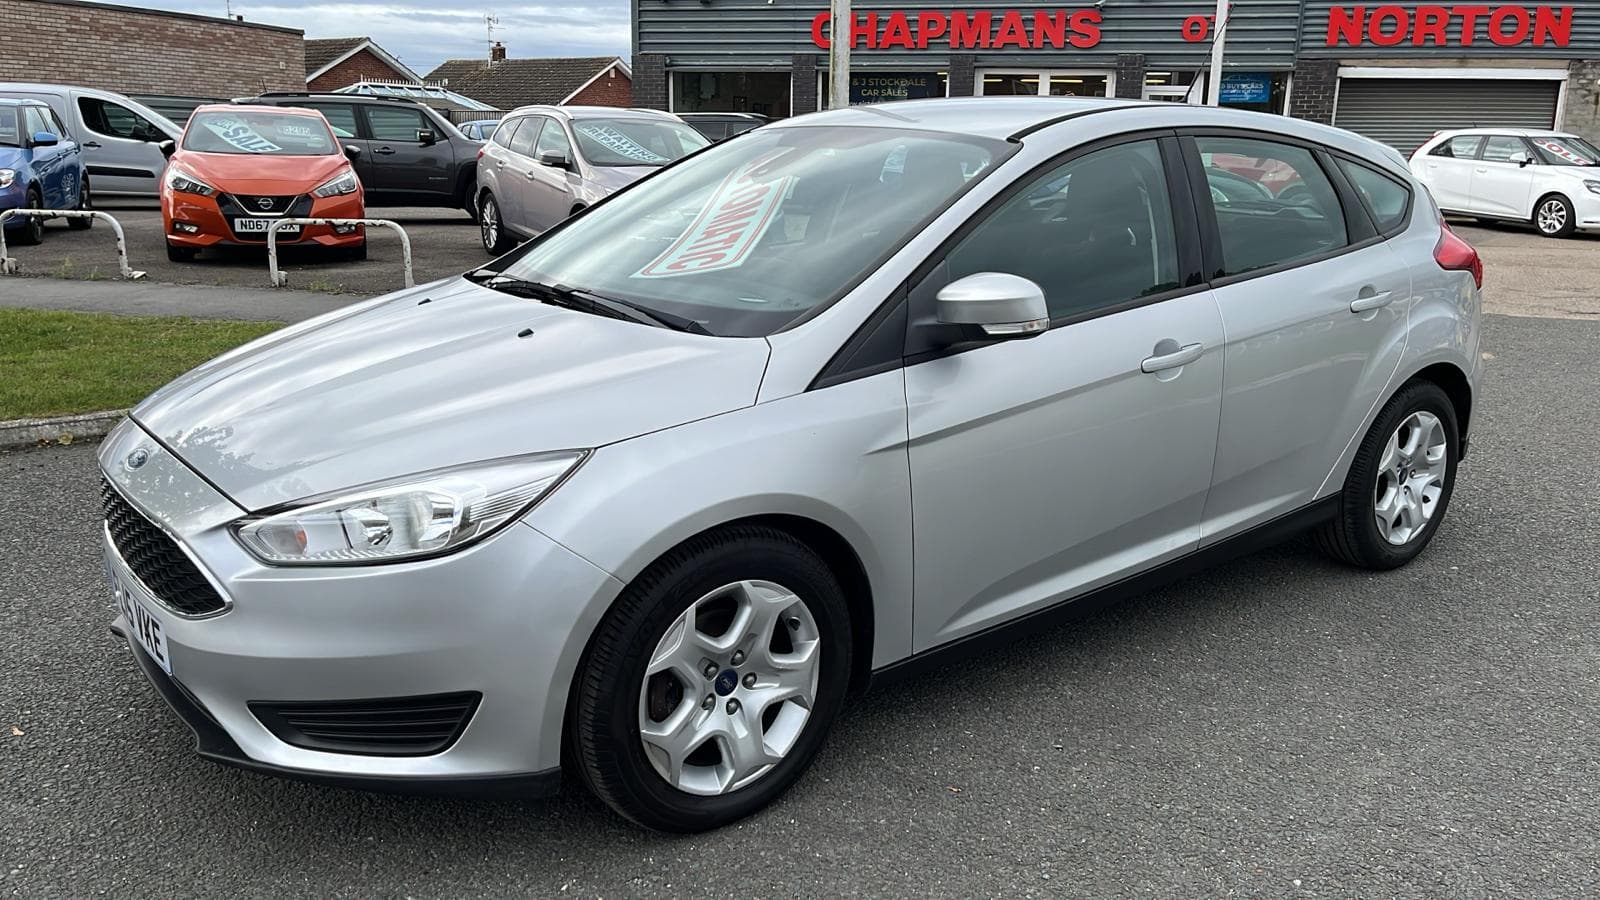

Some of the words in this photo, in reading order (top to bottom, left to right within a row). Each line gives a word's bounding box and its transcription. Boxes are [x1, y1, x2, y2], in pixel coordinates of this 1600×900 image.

[811, 9, 1103, 49] CHAPMANS
[1326, 5, 1575, 47] NORTON
[861, 88, 879, 97] CAR
[881, 88, 908, 97] SALES
[868, 78, 927, 87] STOCKDALE
[223, 126, 274, 152] SALE
[599, 126, 659, 160] WAITING
[240, 220, 270, 230] ND67
[133, 599, 165, 663] VKE
